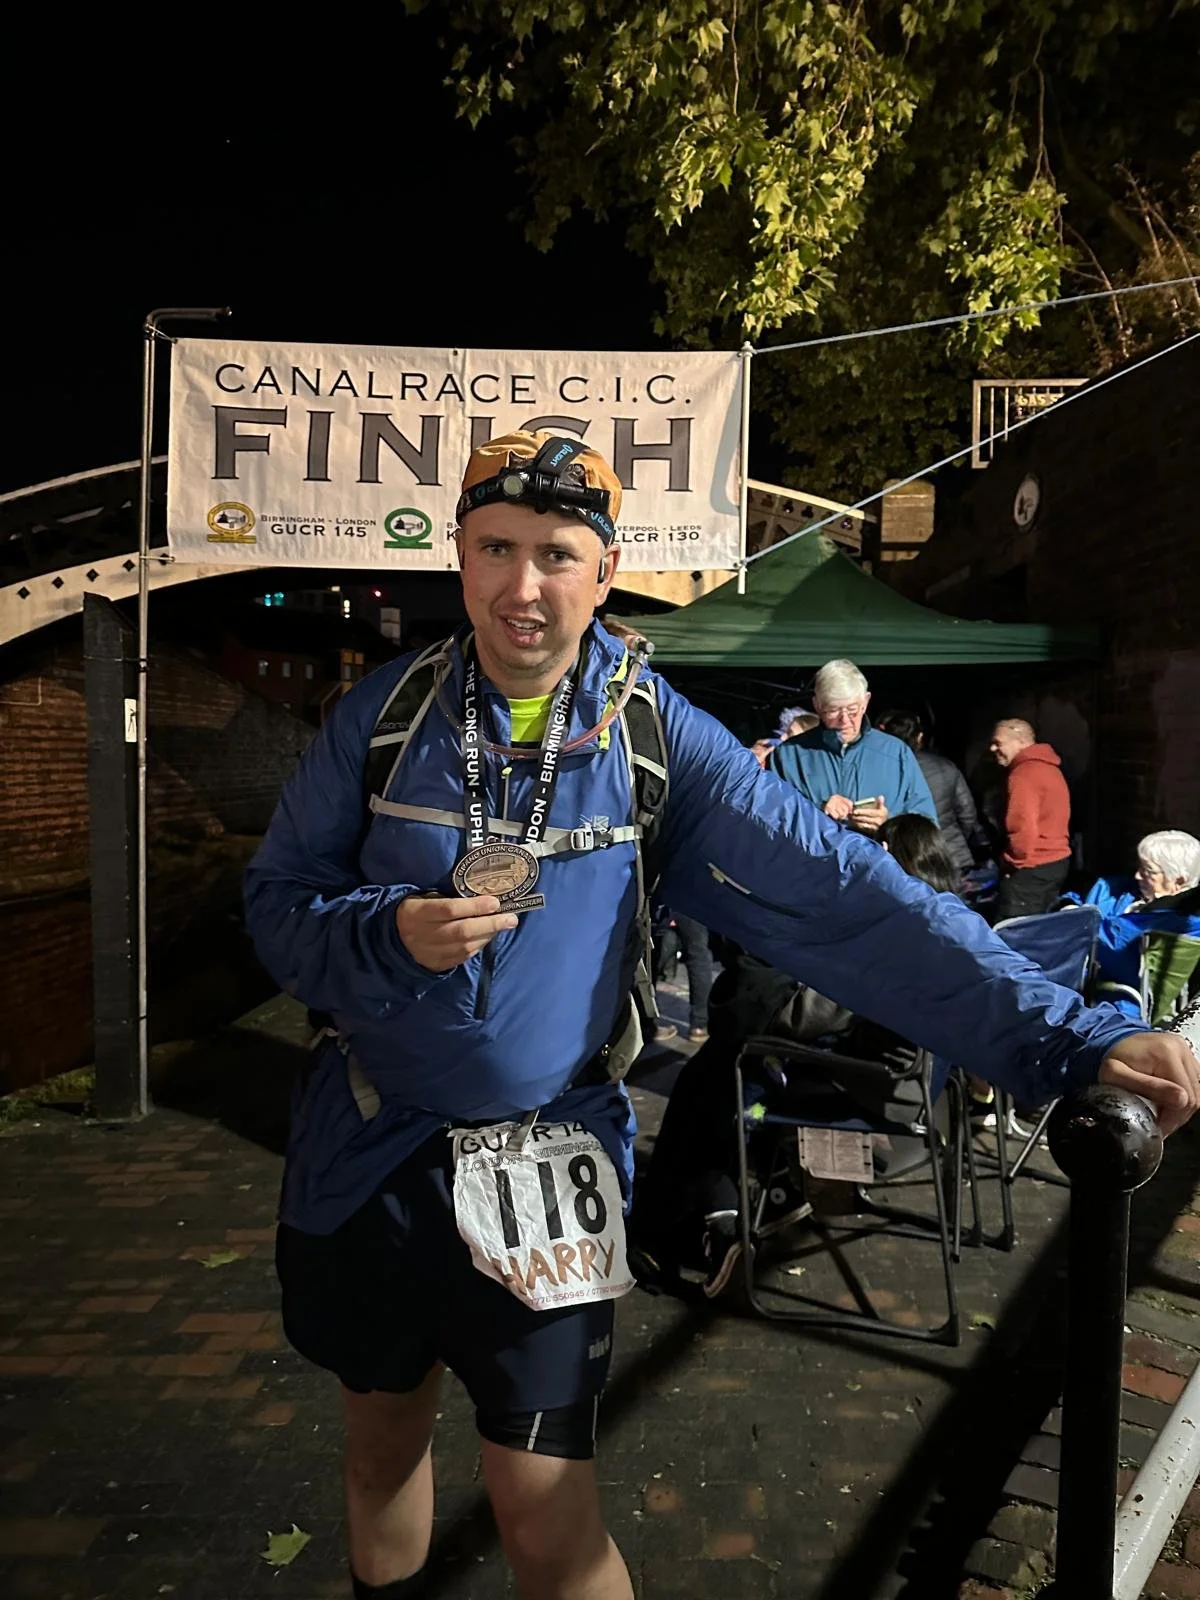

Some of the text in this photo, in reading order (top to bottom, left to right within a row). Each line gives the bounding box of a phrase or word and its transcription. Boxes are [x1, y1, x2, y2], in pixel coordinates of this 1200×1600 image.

[215, 363, 691, 404] CANALRACE C.I.C.
[211, 405, 695, 493] FINH
[260, 514, 325, 524] BIRMINGHAM
[336, 518, 377, 526] LONDON
[271, 523, 367, 538] GUCR 145
[668, 531, 699, 542] 130
[465, 661, 475, 694] THE
[465, 696, 478, 743] LONG
[540, 679, 575, 783] BIRMINGHAM
[466, 747, 480, 787] RUN
[470, 803, 484, 847] UPHI
[460, 1124, 552, 1155] GUR
[494, 1153, 607, 1249] 118
